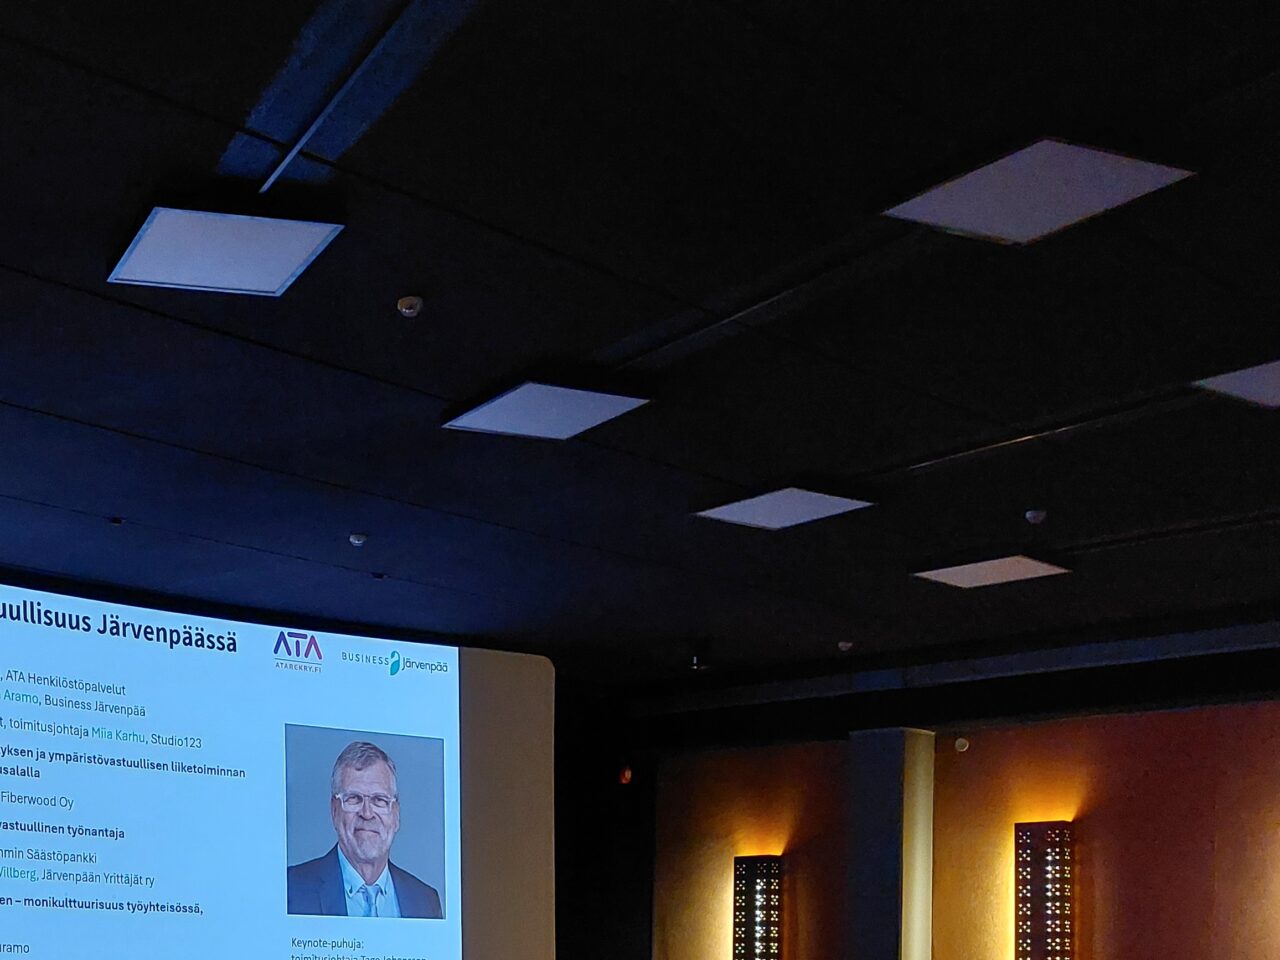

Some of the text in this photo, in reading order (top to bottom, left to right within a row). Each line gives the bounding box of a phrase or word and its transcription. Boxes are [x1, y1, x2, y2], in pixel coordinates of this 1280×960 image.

[96, 614, 237, 653] Järvenpäässä
[273, 631, 323, 660] ATA
[341, 651, 449, 673] BUSINESS Järvenpää
[5, 669, 26, 683] ATA
[28, 672, 126, 696] Henkilöstöpalvelut
[3, 689, 42, 706] Aramo,
[44, 694, 92, 711] Business
[94, 700, 146, 718] Järvenpää
[9, 718, 89, 739] toimitusjohtaja
[92, 727, 113, 740] Miia
[115, 729, 148, 745] Karhu,
[150, 733, 202, 749] Studio123
[35, 747, 46, 762] ja
[48, 751, 169, 771] ympäristövastuullisen
[171, 760, 246, 778] liiketoiminnan
[0, 791, 56, 807] Fiberwood
[59, 796, 74, 811] Oy
[67, 824, 125, 841] työnantaja
[26, 848, 97, 865] Säästöpankki
[41, 869, 101, 885] Järvenpään
[103, 872, 143, 888] Yrittäjät
[145, 877, 155, 889] ry
[24, 896, 124, 911] monikulttuurisuus
[126, 900, 204, 916] työyhteisössä,
[291, 937, 364, 951] Keynote-puhuja:
